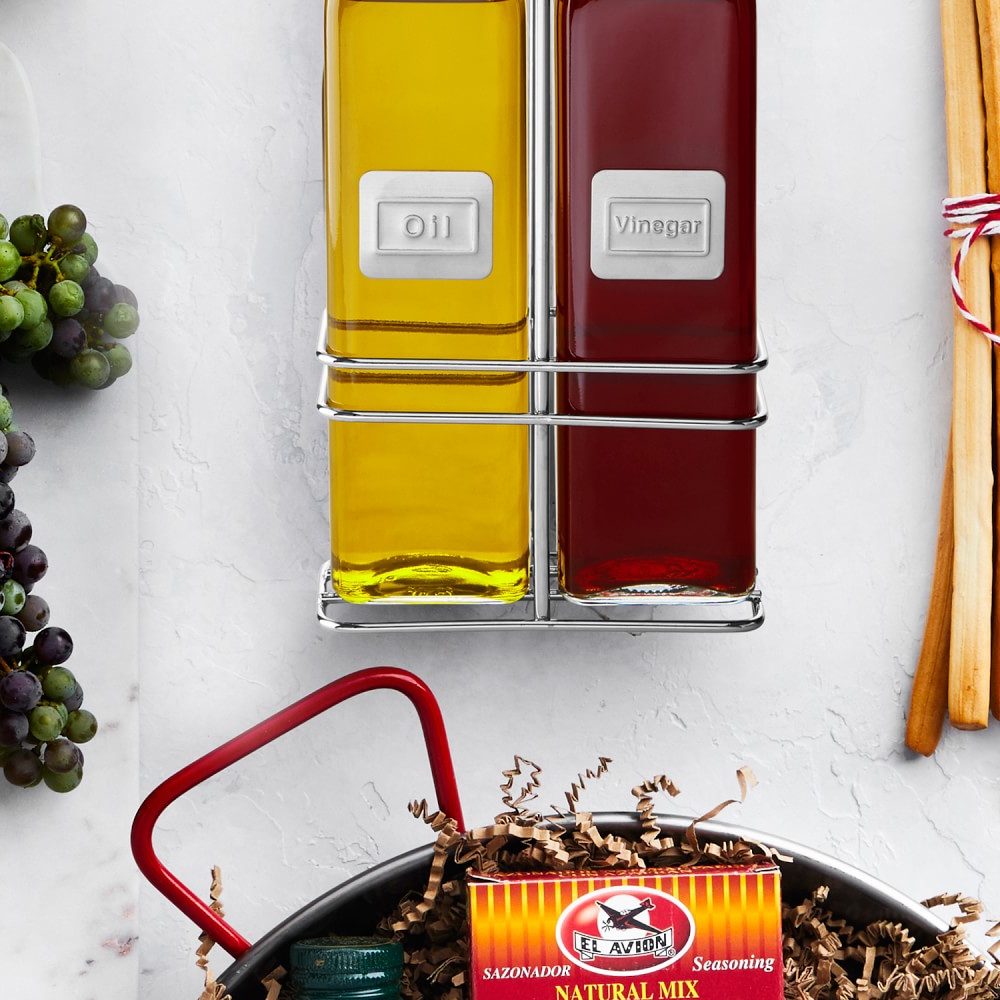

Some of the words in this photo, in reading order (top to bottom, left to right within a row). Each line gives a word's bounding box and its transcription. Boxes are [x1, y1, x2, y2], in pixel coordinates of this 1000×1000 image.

[401, 213, 450, 239] Oil
[613, 213, 702, 239] Vinegar
[581, 936, 601, 953] EL
[609, 933, 667, 954] AVION
[483, 965, 571, 980] SAZONADOR
[692, 954, 775, 972] Seasoning
[658, 979, 700, 1000] MIX
